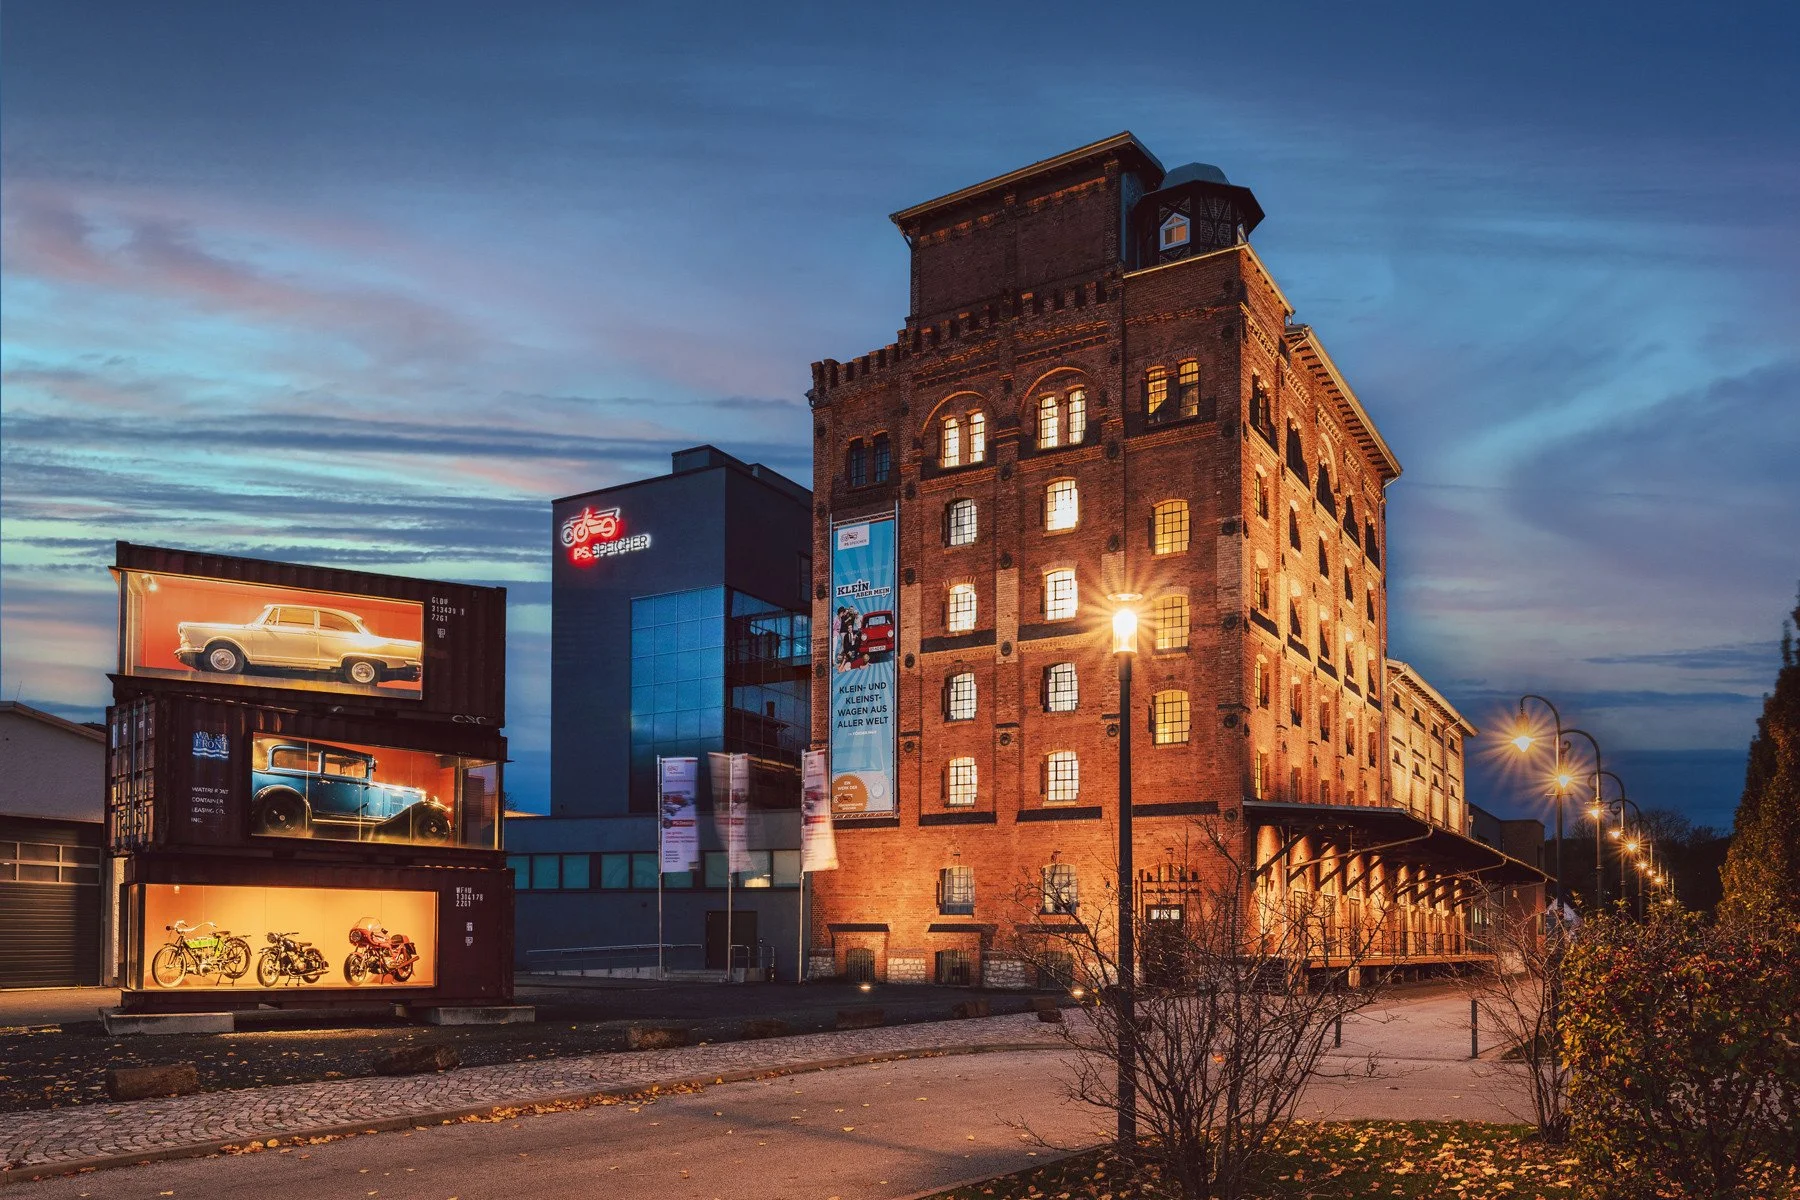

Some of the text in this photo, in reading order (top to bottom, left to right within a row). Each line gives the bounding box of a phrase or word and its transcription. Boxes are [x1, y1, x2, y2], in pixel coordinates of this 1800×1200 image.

[856, 590, 873, 598] ABER
[839, 682, 887, 694] KLEIN- UND
[845, 694, 882, 705] KLEINST-
[837, 704, 888, 717] WAGEN AUS
[837, 716, 889, 728] ALLER WELT
